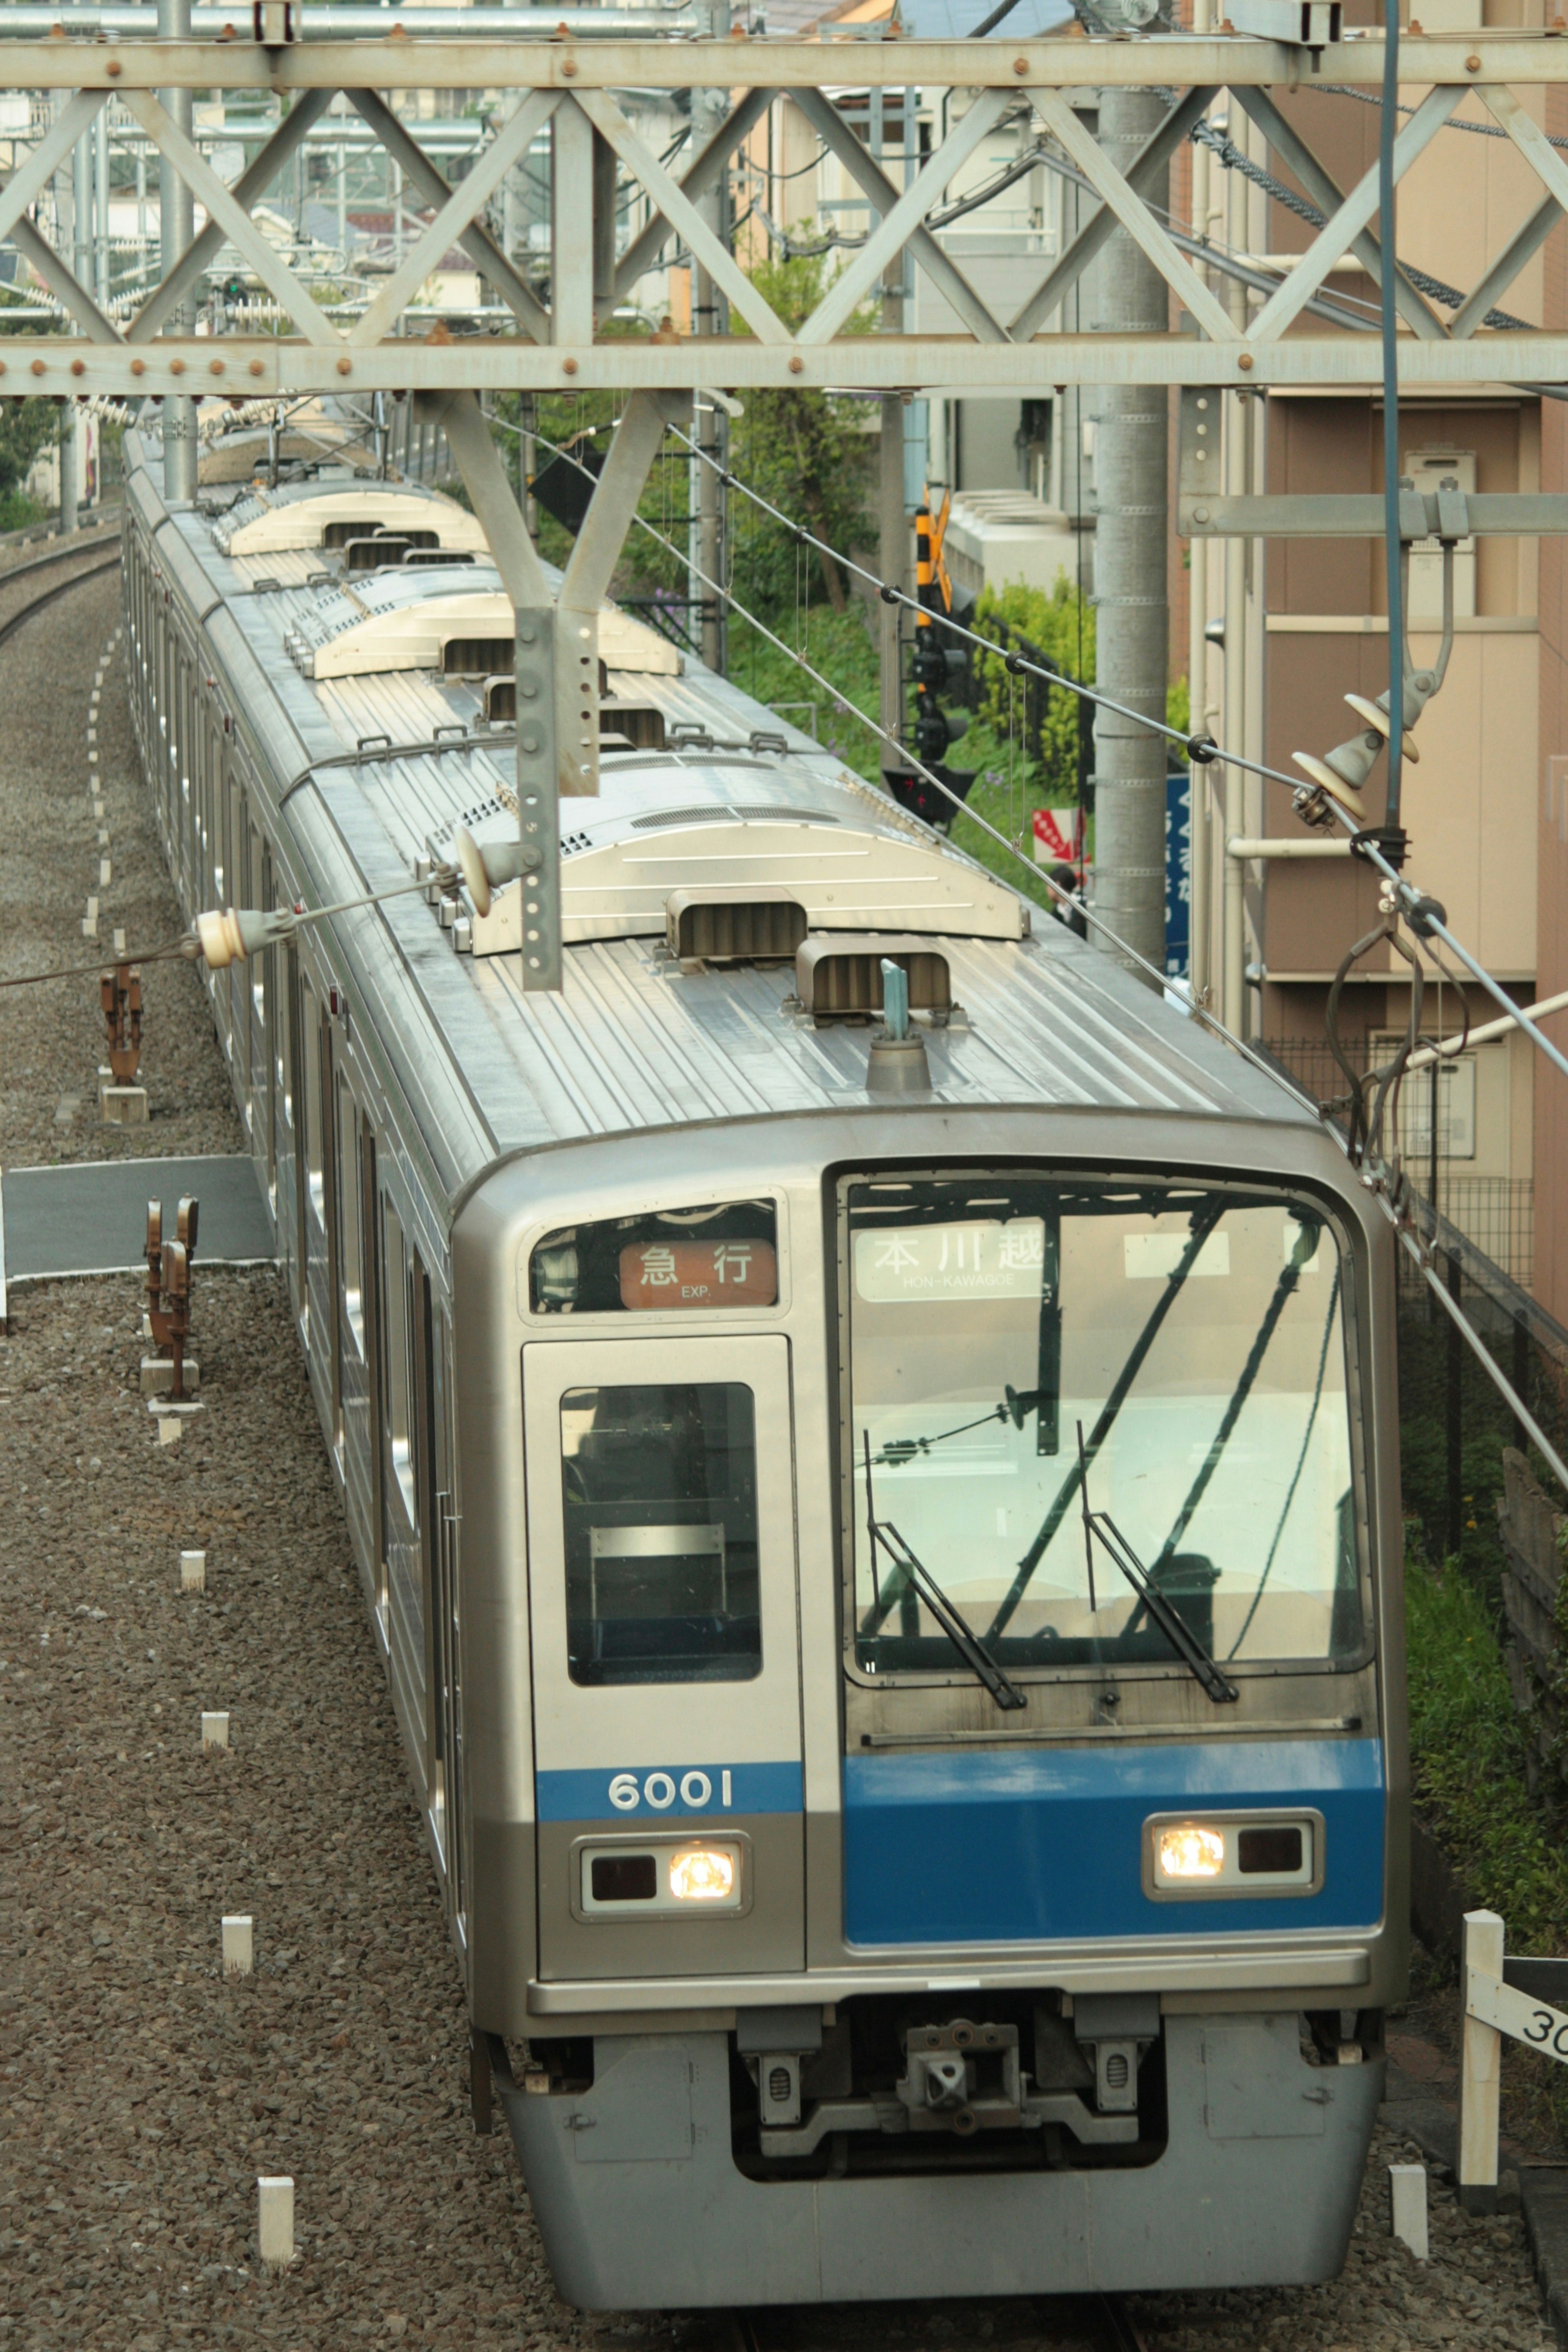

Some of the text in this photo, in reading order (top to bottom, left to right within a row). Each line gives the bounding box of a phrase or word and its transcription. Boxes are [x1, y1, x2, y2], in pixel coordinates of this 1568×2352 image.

[640, 1245, 752, 1285] 急行
[874, 1230, 1044, 1274] 本川越
[904, 1274, 1014, 1288] HON-KAWAGOE
[609, 1770, 731, 1810] 6001
